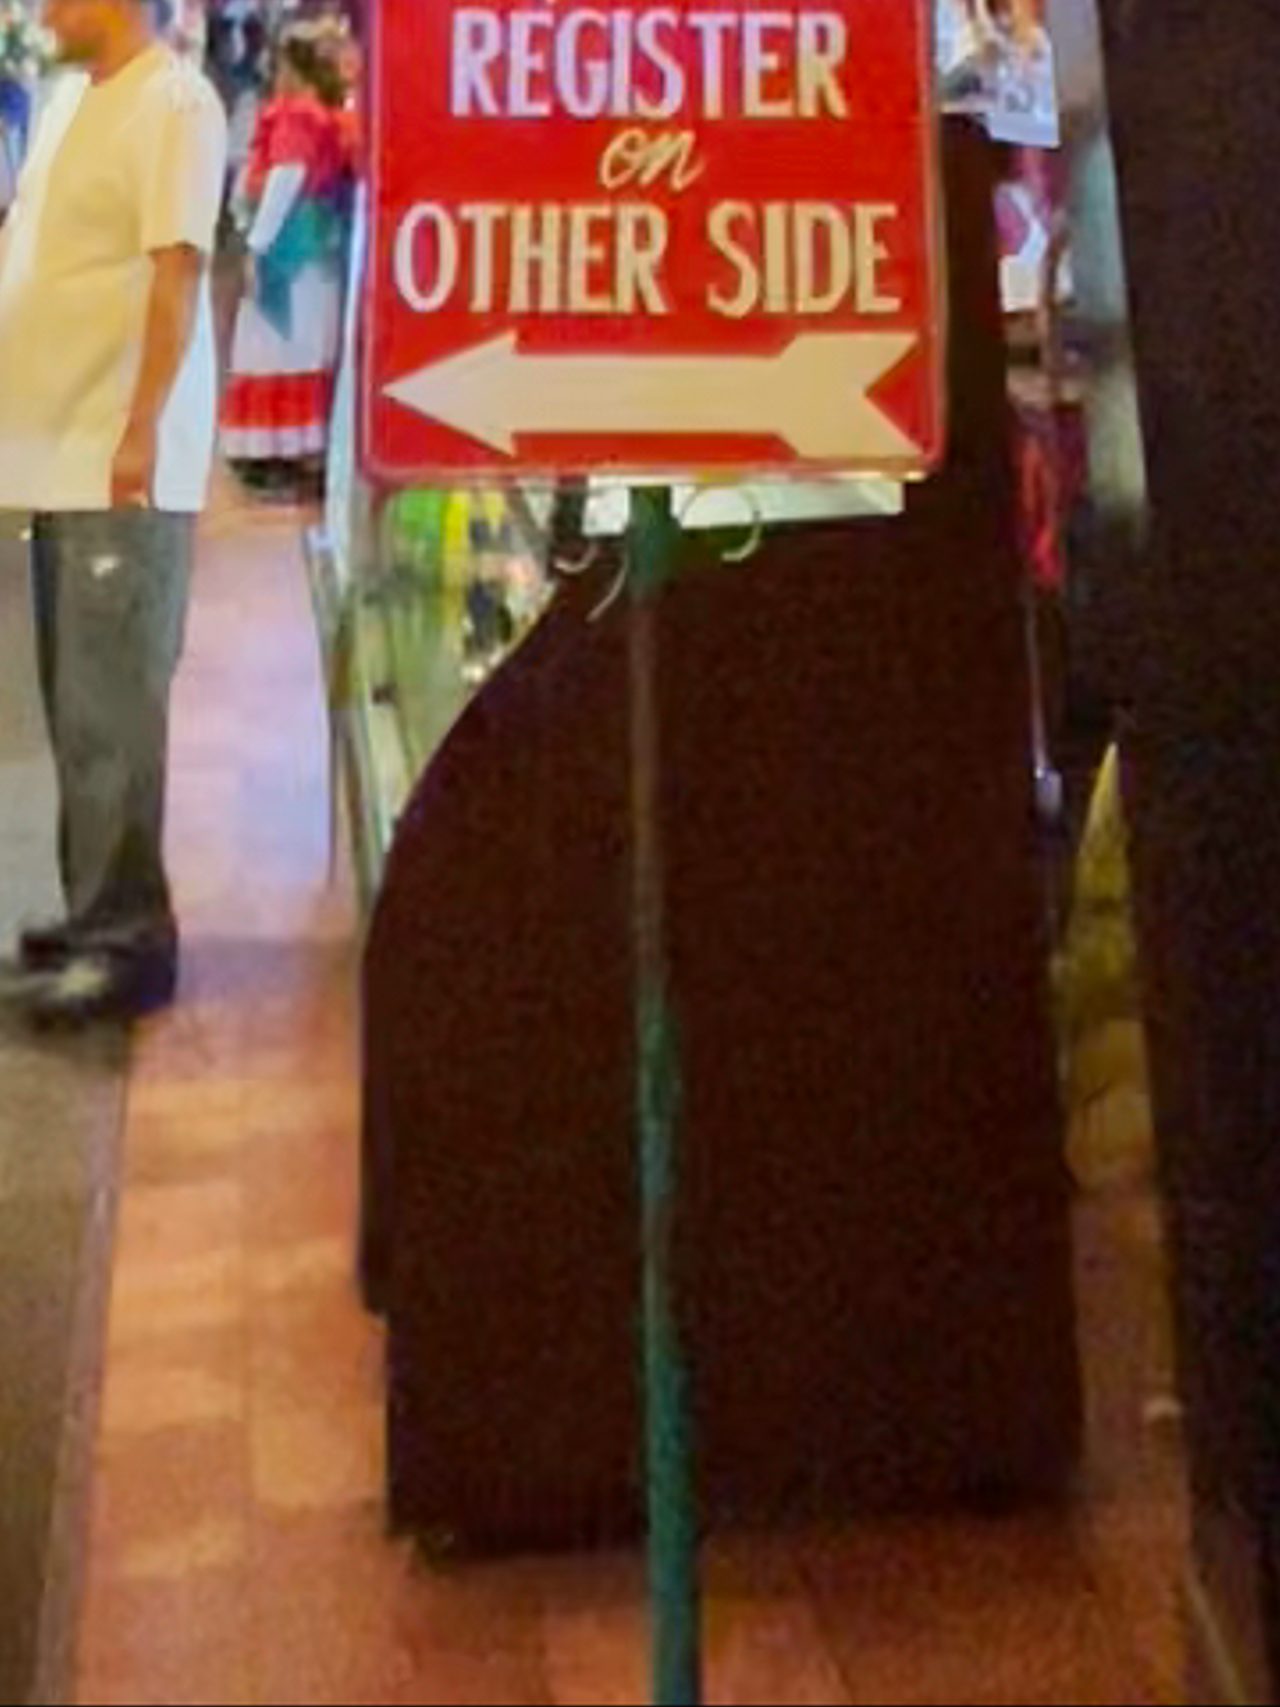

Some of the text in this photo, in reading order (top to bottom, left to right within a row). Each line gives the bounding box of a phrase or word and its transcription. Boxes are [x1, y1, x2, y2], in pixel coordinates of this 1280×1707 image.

[450, 8, 851, 121] REGISTER
[598, 126, 706, 193] on
[392, 199, 903, 318] OTHER SIDE
